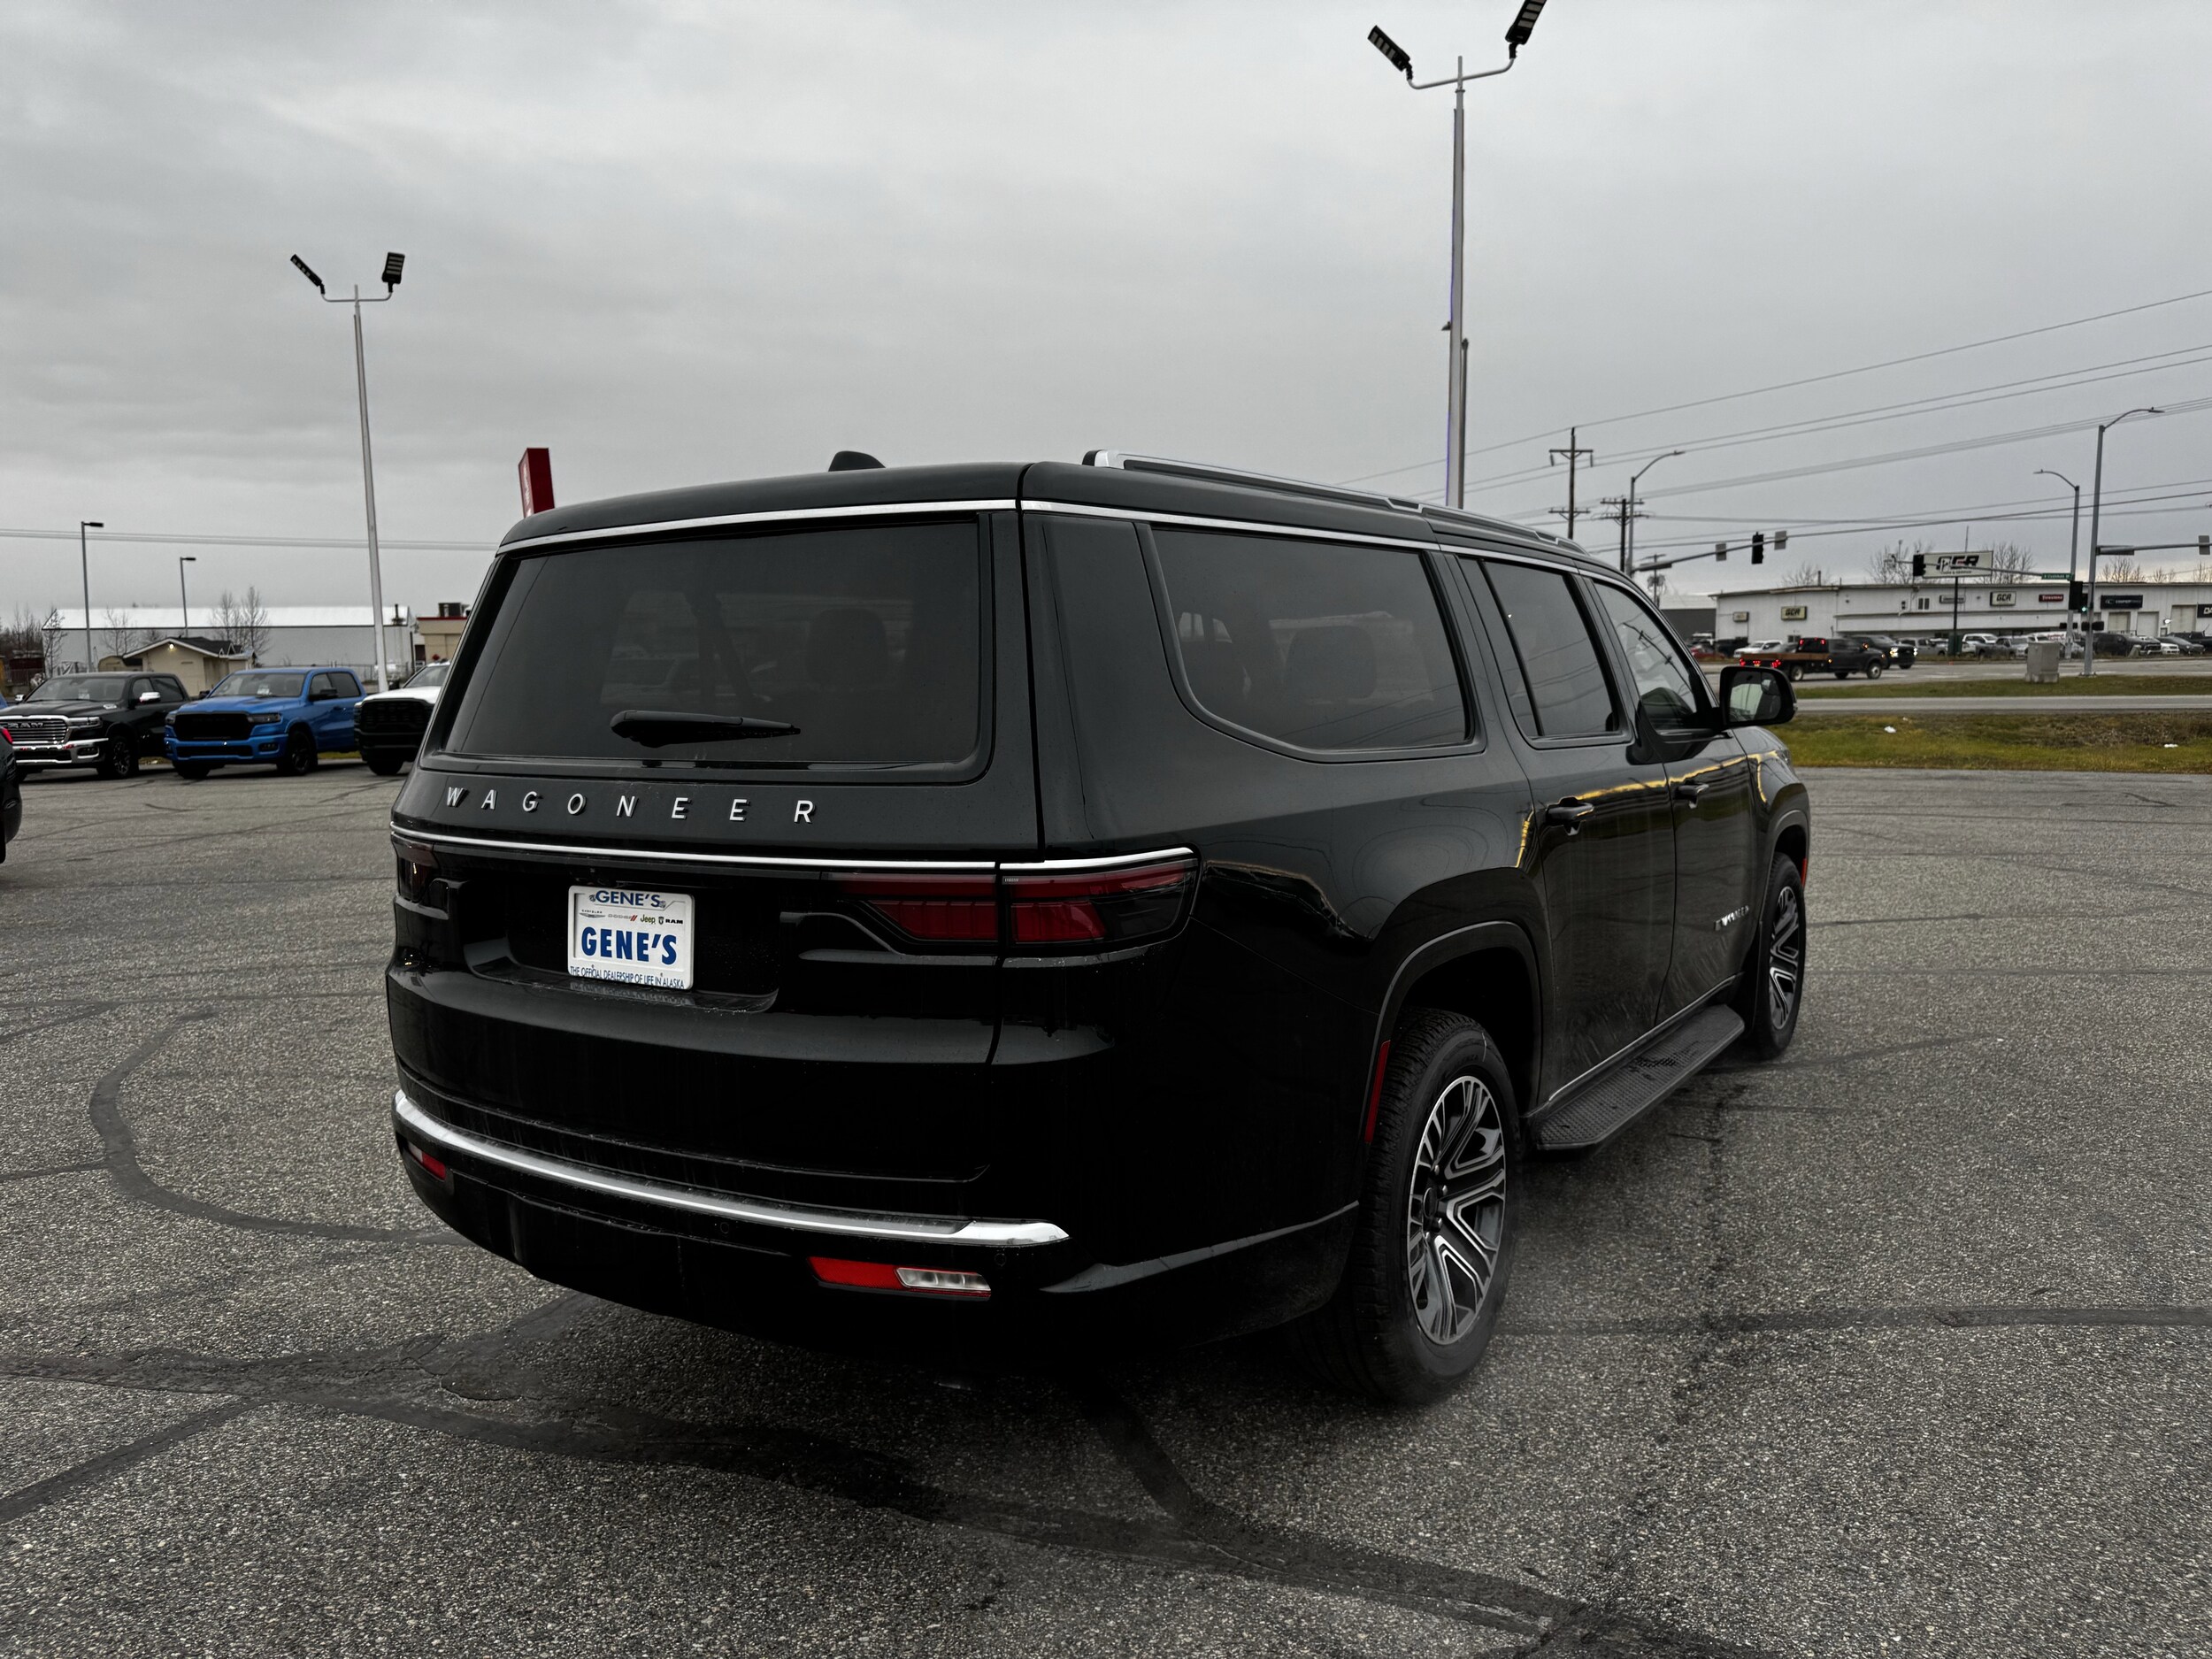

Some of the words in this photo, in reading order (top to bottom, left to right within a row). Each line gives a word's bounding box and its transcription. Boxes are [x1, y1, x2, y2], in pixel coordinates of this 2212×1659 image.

[446, 786, 817, 824] WAGONEER
[595, 890, 662, 908] GENE'S
[640, 914, 657, 925] Jeep
[581, 926, 677, 965] GENE'S
[570, 965, 580, 976] THE
[580, 967, 603, 979] OFFICIAL
[603, 970, 634, 983] DEALERSHIP
[634, 974, 643, 984] OF
[644, 975, 655, 985] LIFE
[655, 976, 662, 986] IN
[663, 978, 685, 988] ALASKA
